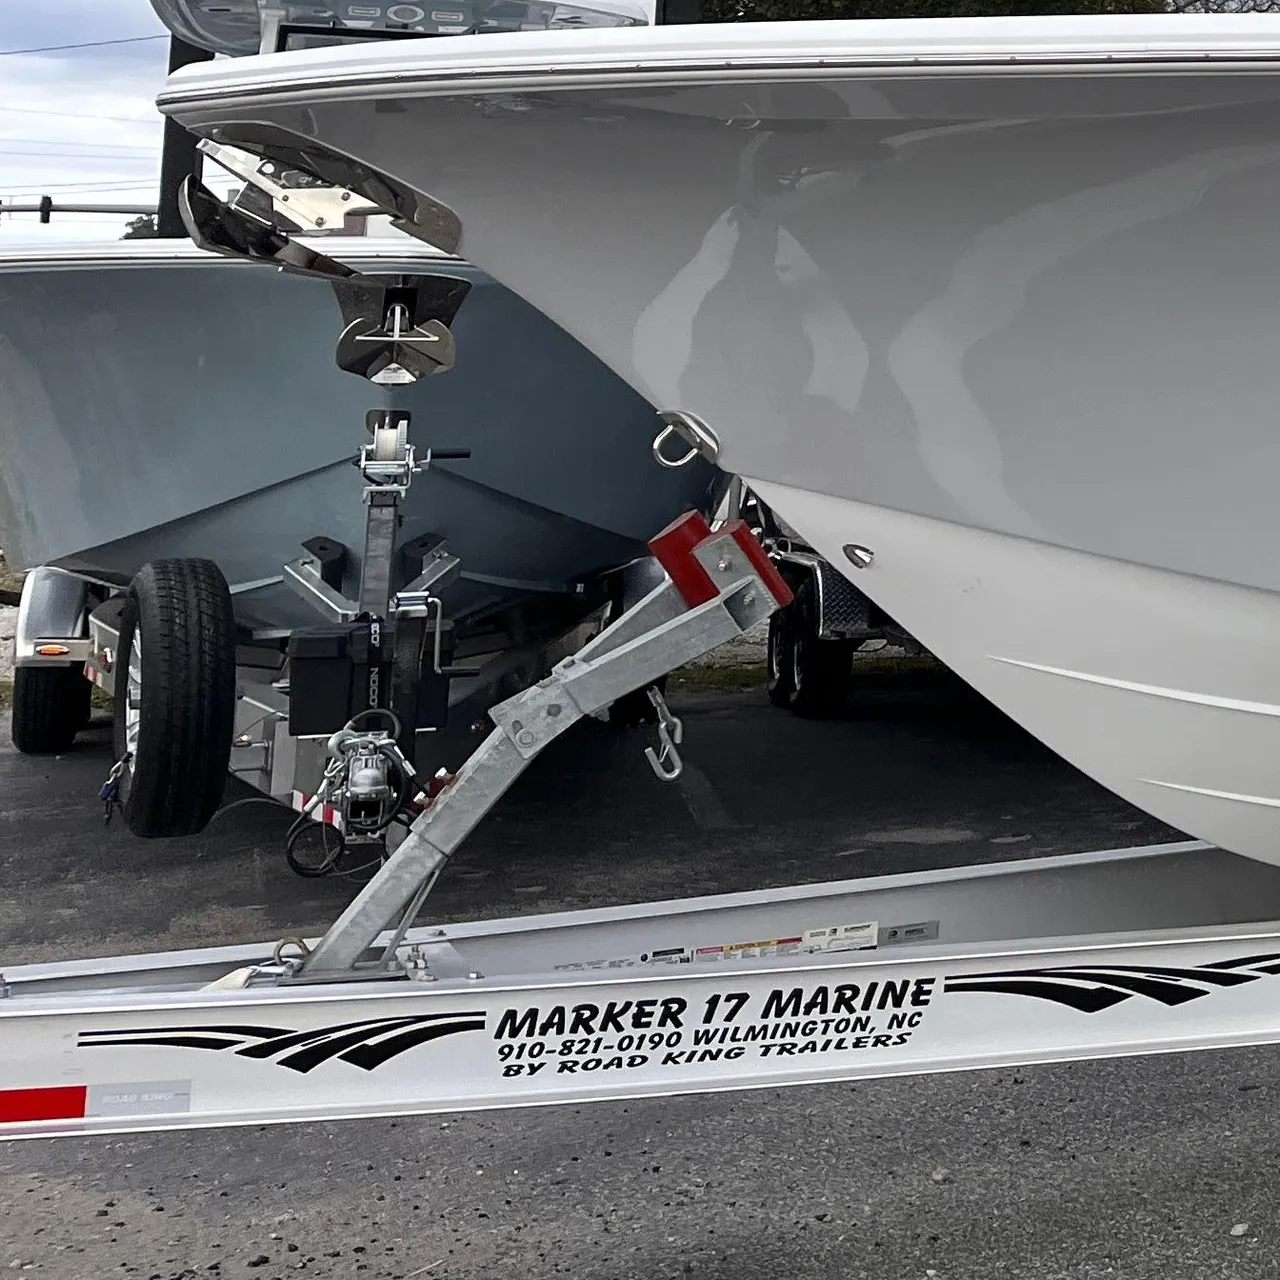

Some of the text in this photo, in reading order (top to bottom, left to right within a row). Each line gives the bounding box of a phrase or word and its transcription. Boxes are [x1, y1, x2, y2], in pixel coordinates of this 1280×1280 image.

[369, 667, 379, 708] NOCO
[494, 977, 936, 1040] MARKER 17 MARINE
[497, 1011, 924, 1062] 910-821-0190 WILMINGTON, NC
[502, 1032, 913, 1078] BY ROAD KING TRAILERS
